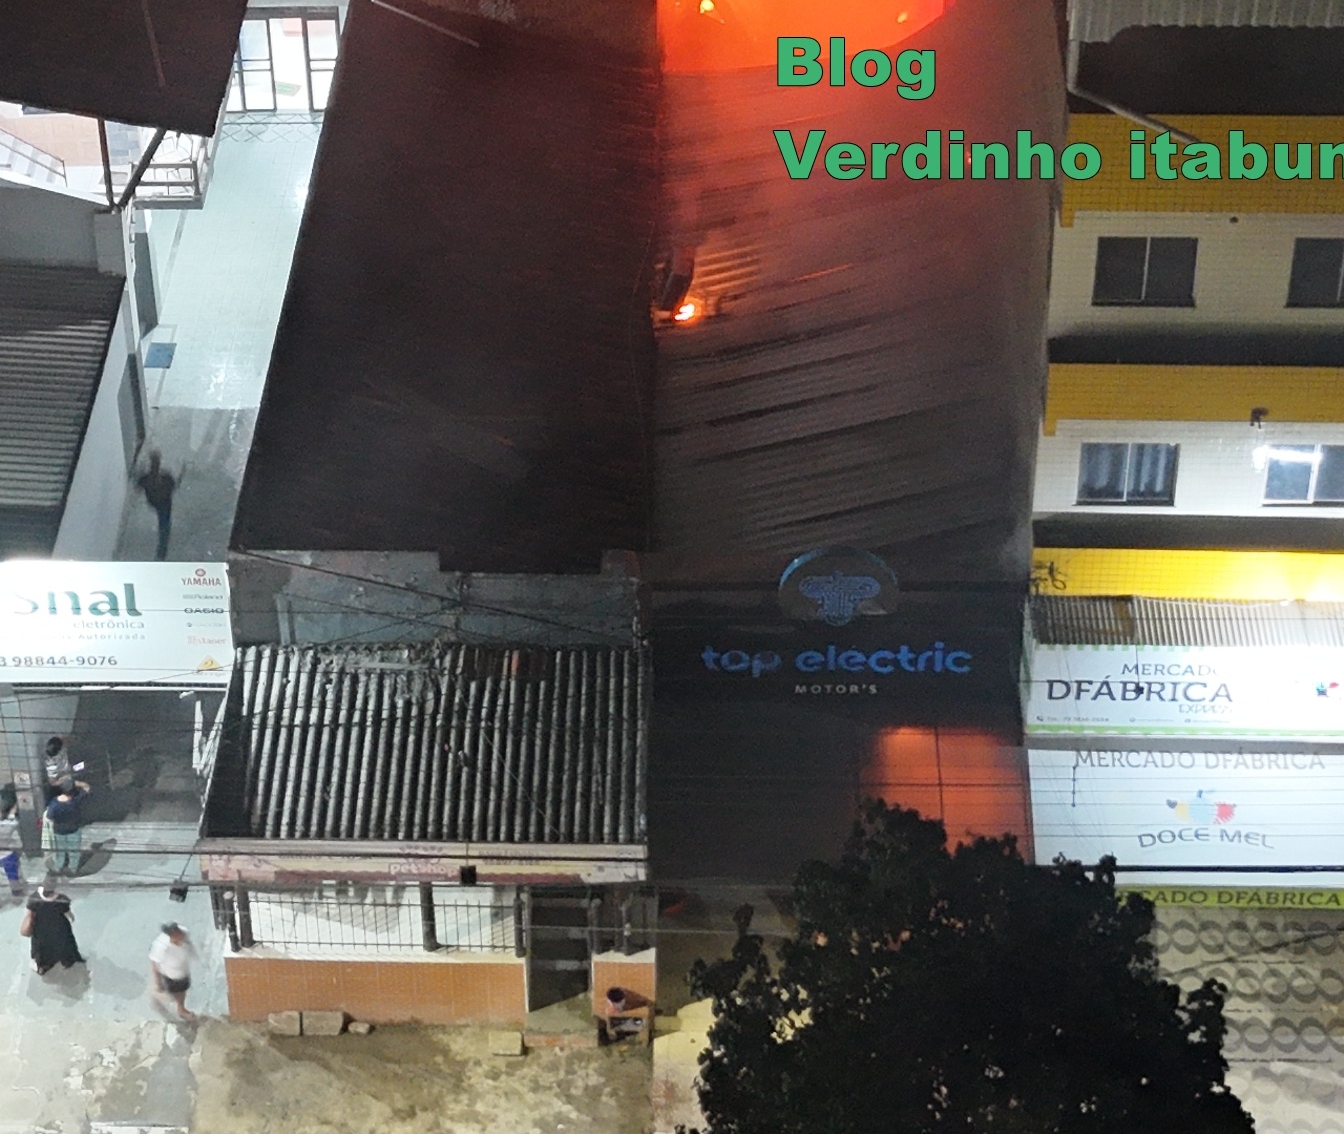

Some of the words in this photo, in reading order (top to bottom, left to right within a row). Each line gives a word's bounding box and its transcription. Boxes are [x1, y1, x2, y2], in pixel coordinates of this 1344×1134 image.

[181, 577, 222, 586] YAMAHA
[73, 619, 146, 630] eletrônica
[12, 655, 119, 667] 98844-9076
[701, 645, 782, 678] top
[795, 641, 973, 674] electric
[1120, 663, 1219, 676] MERCAD
[794, 683, 878, 695] MOTOR'S
[1047, 675, 1234, 702] DFÁBRICA
[1074, 750, 1196, 770] MERCADO
[1204, 747, 1326, 770] DFÁBRICA
[1138, 827, 1211, 848] DOCE
[1219, 829, 1275, 849] MEL
[1216, 888, 1342, 906] DFÁBRICA
